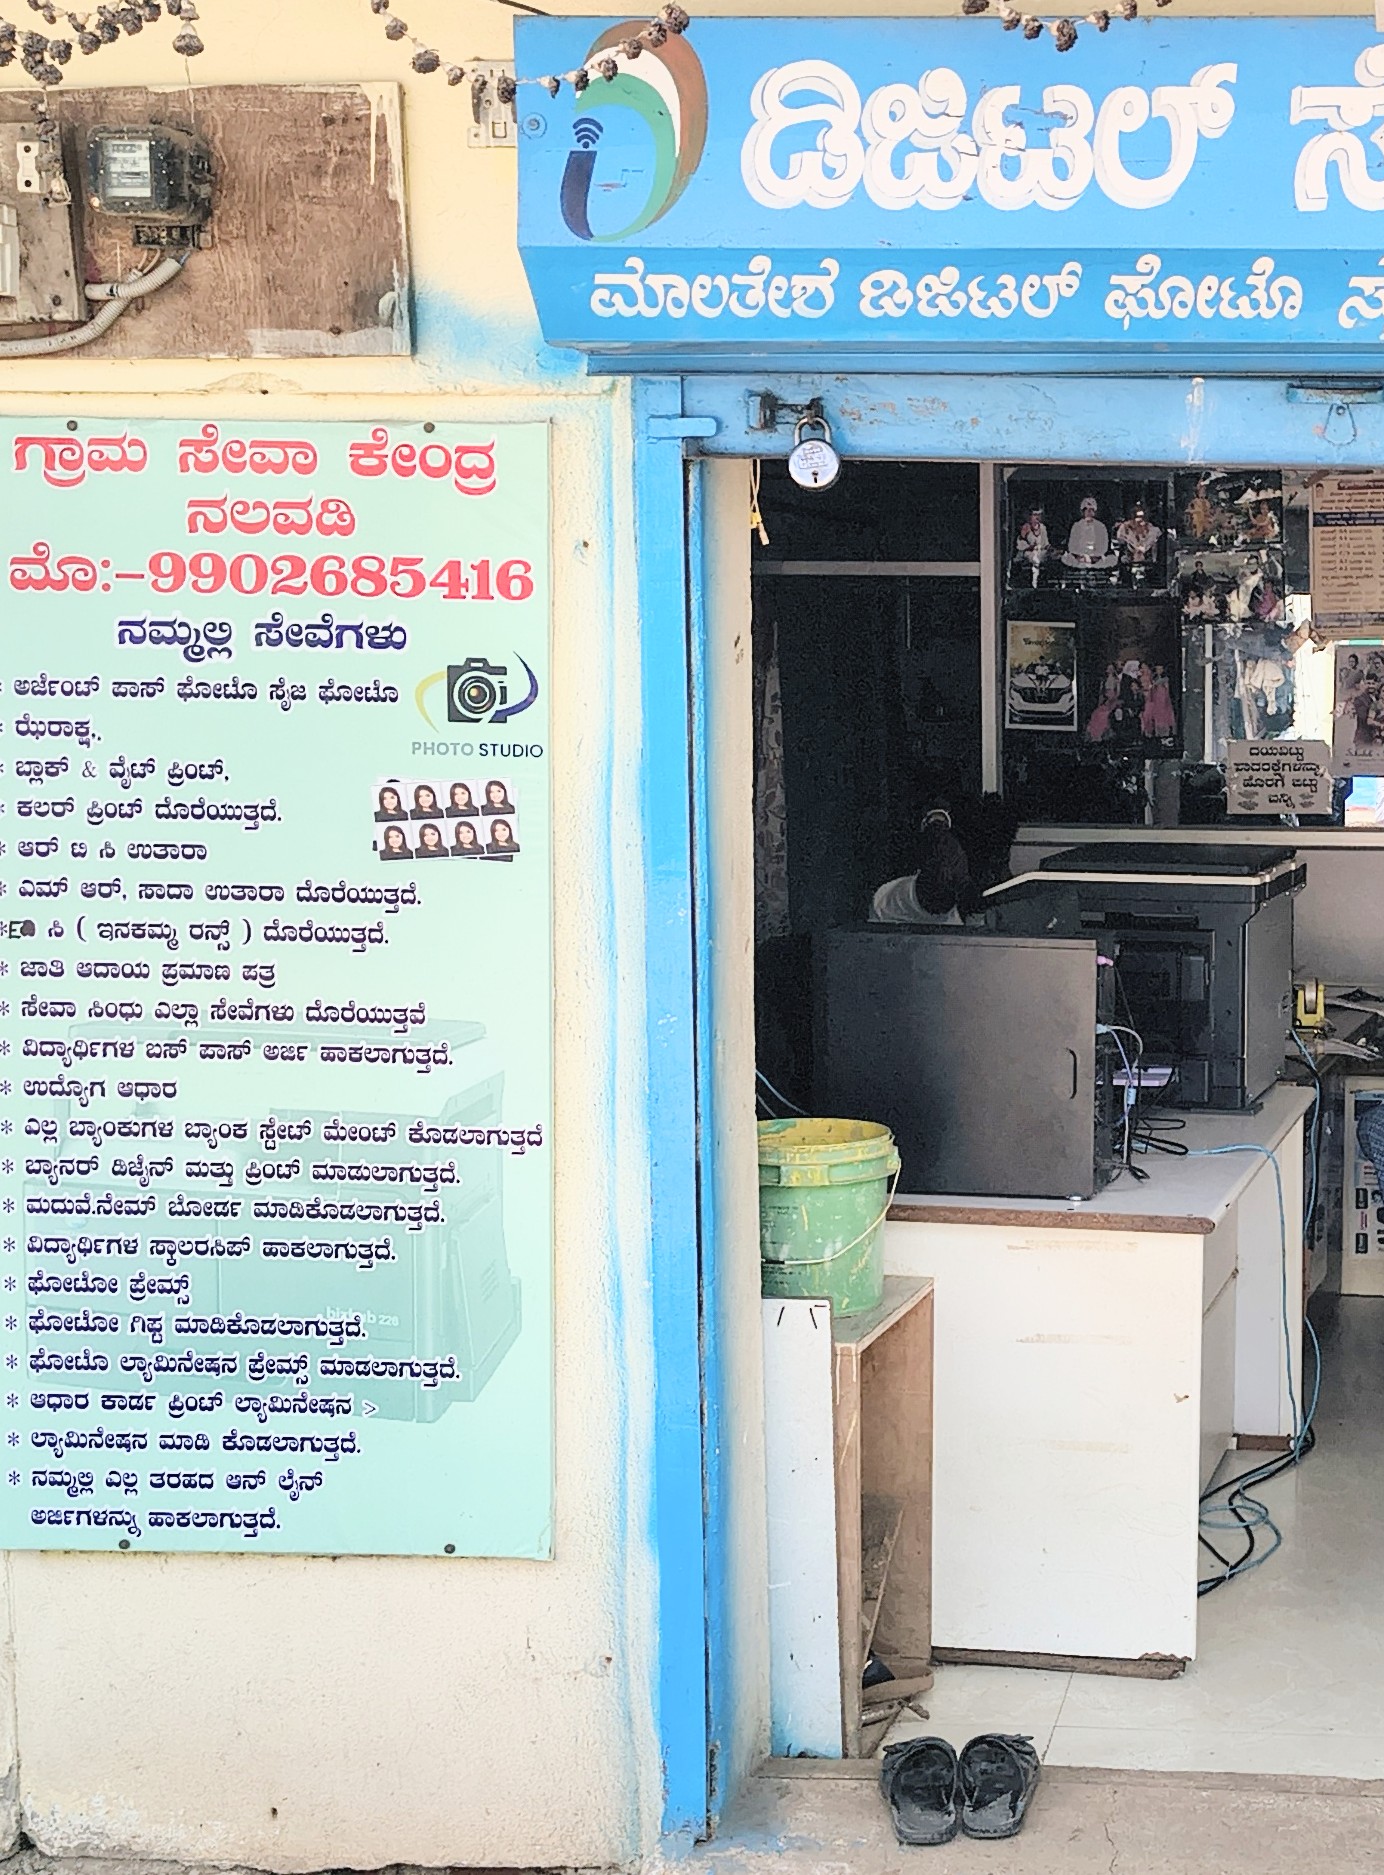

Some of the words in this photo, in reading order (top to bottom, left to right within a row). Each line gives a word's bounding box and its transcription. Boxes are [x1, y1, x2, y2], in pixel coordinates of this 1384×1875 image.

[741, 59, 1238, 211] ಡಿಜಿಟಲ್
[860, 262, 1082, 319] ಡಿಜಿಟಲ್
[14, 435, 148, 488] ಗ್ರಾಮ
[178, 423, 318, 475] ಸೇವಾ
[349, 427, 497, 496] ಕೇಂದ್ರ
[187, 497, 356, 537] ನಲವಡಿ
[117, 618, 233, 663] ನಮ್ಮಲ್ಲಿ
[254, 611, 407, 650] ಸೇವೆಗಳು
[112, 676, 165, 698] ಪಾಸ್
[412, 742, 473, 756] PHOTO
[479, 742, 543, 758] STUDIO
[15, 756, 69, 785] ಬ್ಲಾಕ್
[82, 760, 96, 778] &
[17, 796, 75, 818] ಕಲರ್
[86, 797, 143, 826] ಪ್ರಿಂಟ್
[155, 796, 282, 831] ದೊರೆಯುತ್ತದೆ.
[18, 836, 59, 858] ಆರ್
[70, 842, 88, 859] ಟಿ
[99, 841, 116, 859] ಸಿ
[127, 843, 207, 861] ಉತಾರಾ
[18, 876, 68, 898] ಎಮ್
[138, 883, 194, 900] ಸಾದಾ
[205, 884, 285, 902] ಉತಾರಾ
[296, 879, 422, 914] ದೊರೆಯುತ್ತದೆ.
[263, 918, 389, 953] ದೊರೆಯುತ್ತದೆ.
[20, 959, 65, 978] ಜಾತಿ
[76, 962, 150, 979] ಆದಾಯ
[162, 962, 231, 987] ಪ್ರಮಾಣ
[242, 964, 276, 989] ಪತ್ರ
[21, 993, 76, 1018] ಸೇವಾ
[88, 1000, 143, 1022] ಸಿಂಧು
[154, 1001, 199, 1028] ಎಲ್ಲಾ
[210, 997, 294, 1022] ಸೇವೆಗಳು
[305, 999, 426, 1034] ದೊರೆಯುತ್ತವೆ
[145, 1038, 187, 1059] ಬಸ್
[199, 1039, 251, 1061] ಪಾಸ್
[117, 1081, 177, 1102] ಆಧಾರ
[24, 1117, 58, 1143] ಎಲ್ಲ
[69, 1120, 174, 1148] ಬ್ಯಾಂಕುಗಳ
[184, 1122, 248, 1150] ಬ್ಯಾಂಕ
[408, 1120, 543, 1156] ಕೊಡಲಾಗುತ್ತದೆ
[25, 1155, 99, 1186] ಬ್ಯಾನರ್
[185, 1161, 234, 1188] ಮತ್ತು
[30, 1393, 90, 1413] ಆಧಾರ
[158, 1433, 210, 1451] ಮಾಡಿ
[222, 1428, 361, 1462] ಕೊಡಲಾಗುತ್ತದೆ.
[31, 1469, 94, 1498] ನಮ್ಮಲ್ಲಿ
[105, 1470, 139, 1496] ಎಲ್ಲ
[149, 1471, 214, 1490] ತರಹದ
